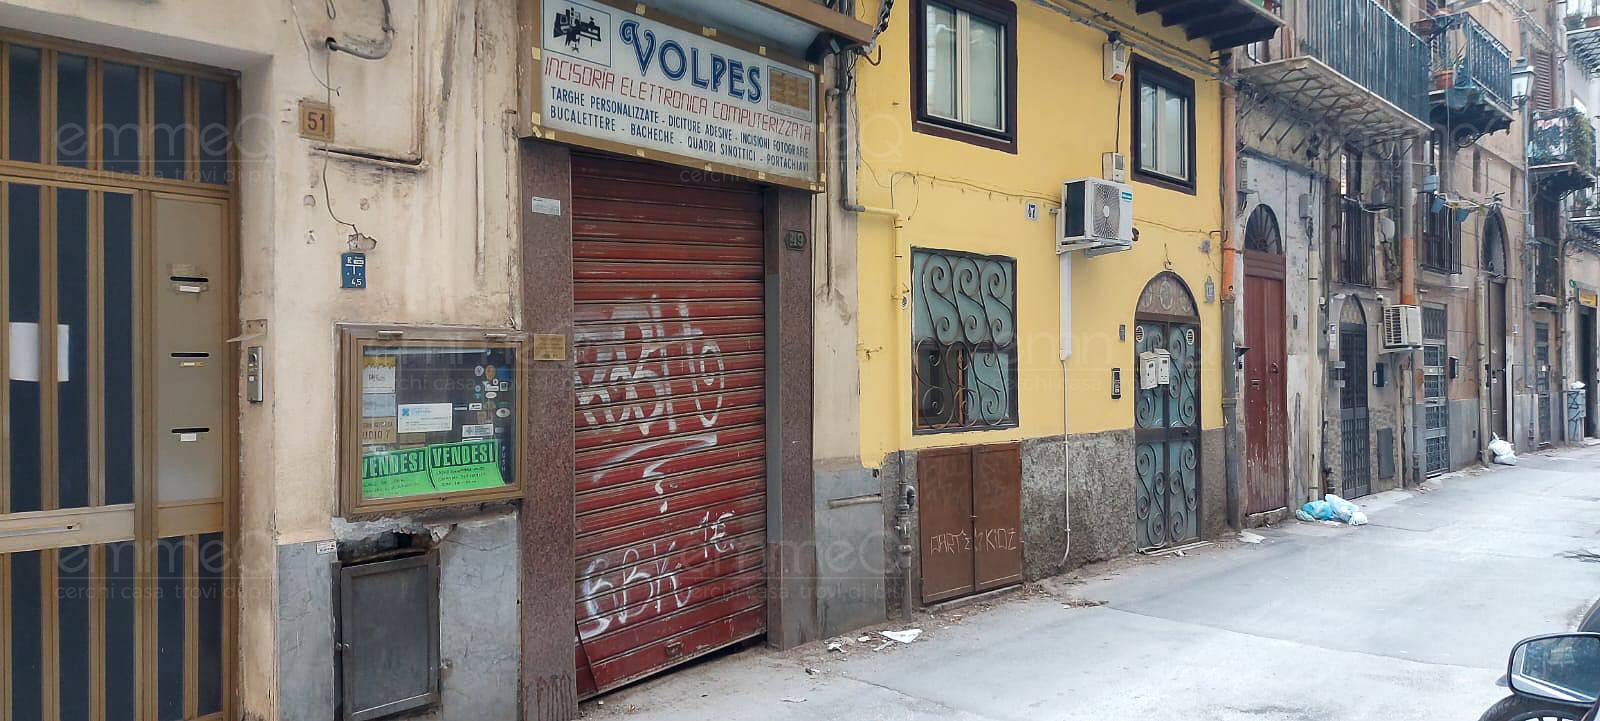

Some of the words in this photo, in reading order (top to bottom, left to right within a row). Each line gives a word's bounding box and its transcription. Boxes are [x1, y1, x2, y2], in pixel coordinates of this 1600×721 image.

[619, 19, 762, 103] VOLPES
[308, 112, 325, 132] 51
[545, 57, 615, 92] INCISORIA
[620, 77, 708, 116] ELETTRONICA
[712, 101, 811, 141] COMPUTERIZZATA
[551, 86, 585, 107] TARGHE
[590, 95, 659, 124] PERSONALIZZATE
[668, 114, 701, 134] DICITURE
[705, 123, 733, 141] ADESIVE
[740, 131, 770, 150] INCISIONI
[772, 139, 809, 159] FOTOGRAFIE
[550, 104, 616, 132] BUCALETTERE
[630, 123, 674, 144] BACHECHE
[687, 135, 716, 153] QUADRI
[720, 143, 756, 161] SINOTTICI
[766, 153, 809, 173] PORTACHIAVI
[432, 442, 494, 467] VENDESI
